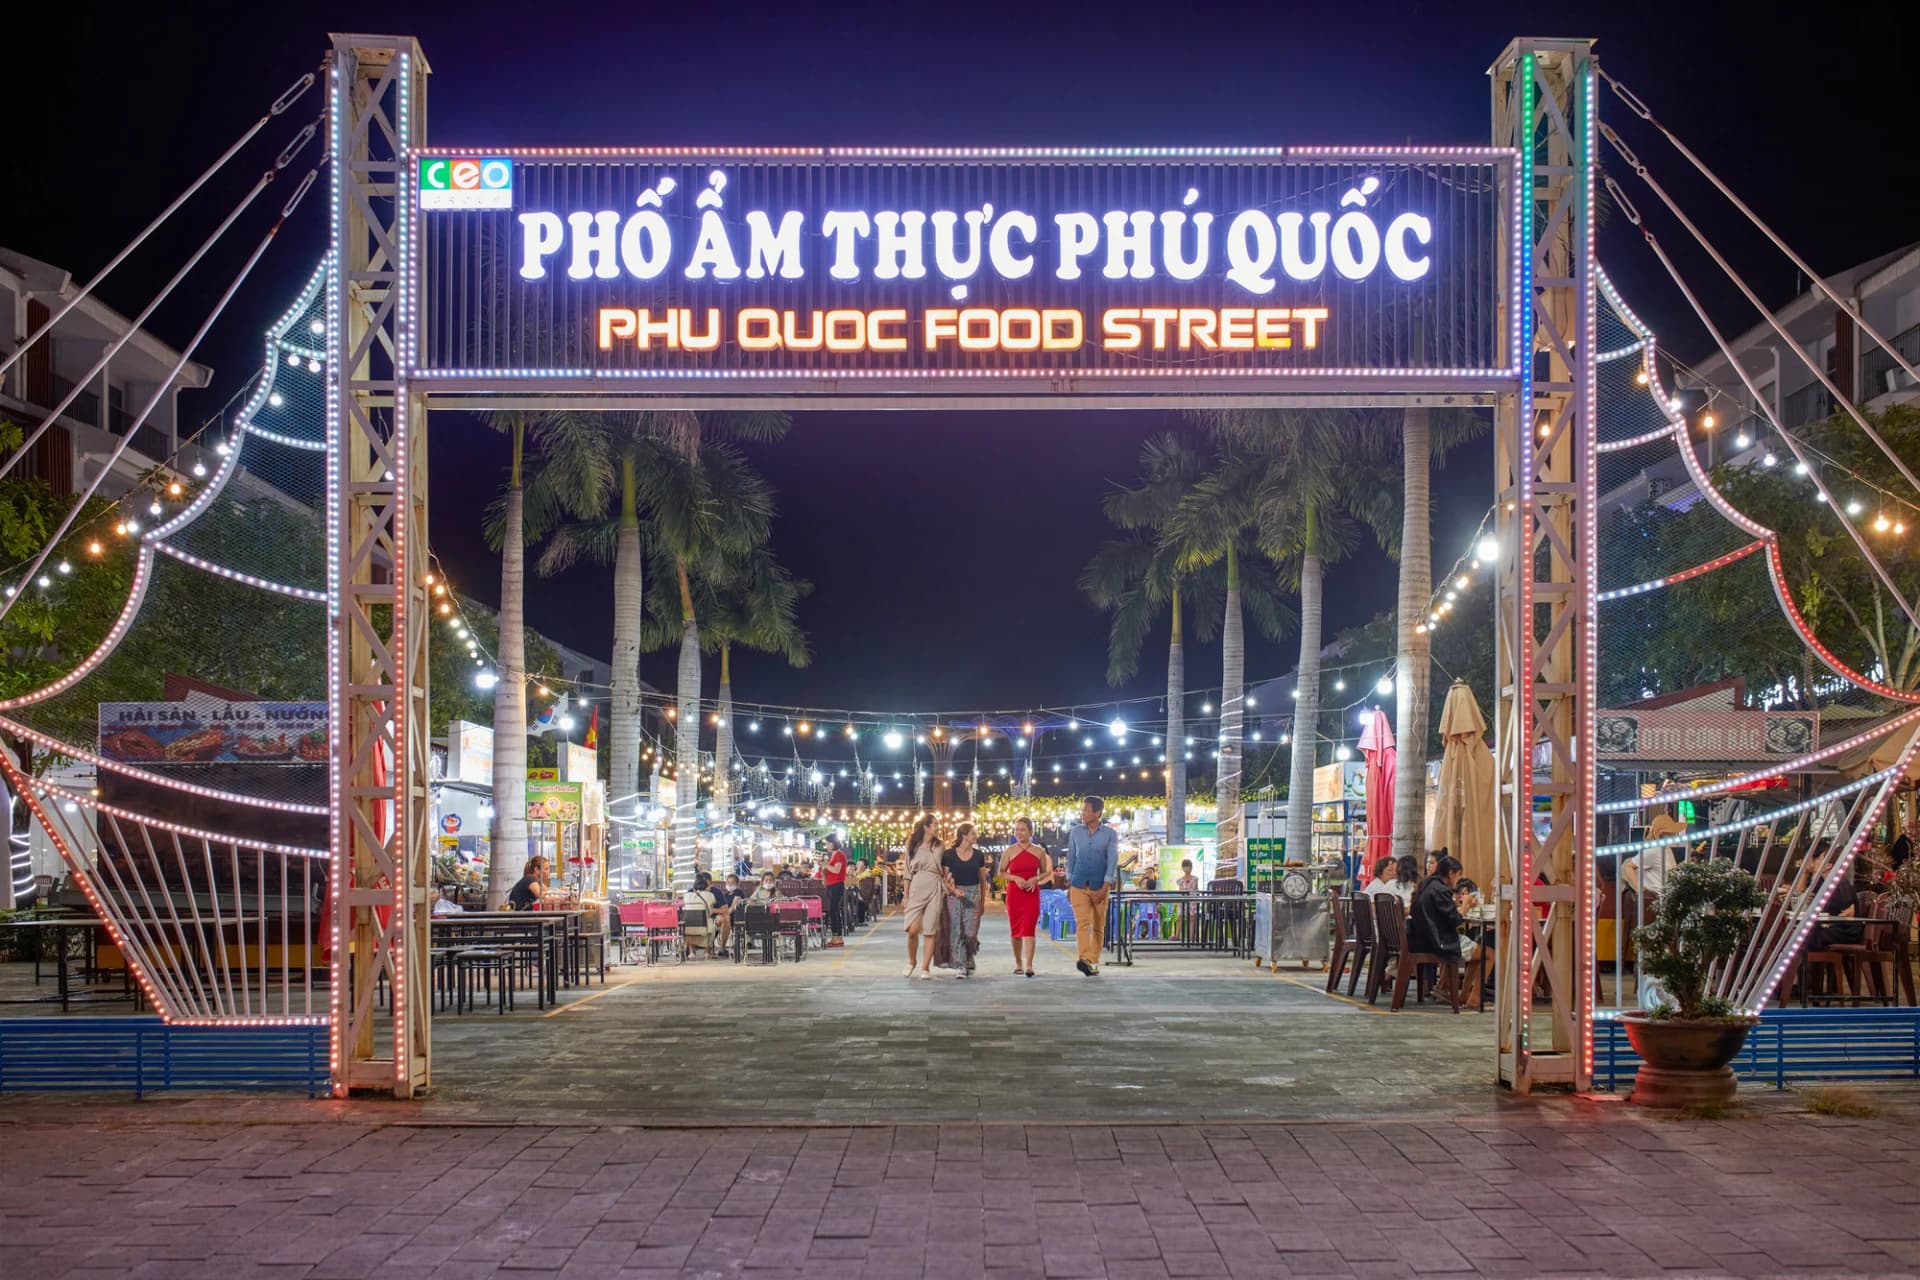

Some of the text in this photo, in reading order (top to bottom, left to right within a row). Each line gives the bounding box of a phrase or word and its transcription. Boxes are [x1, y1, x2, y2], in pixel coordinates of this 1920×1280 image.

[518, 170, 1432, 301] PHỐ ẨM THỰC PHÚ QUỐC
[599, 308, 1330, 351] PHU QUOC FOOD STREET
[119, 706, 153, 722] HẢI
[158, 706, 197, 721] SẢN
[212, 703, 250, 721] LẨU
